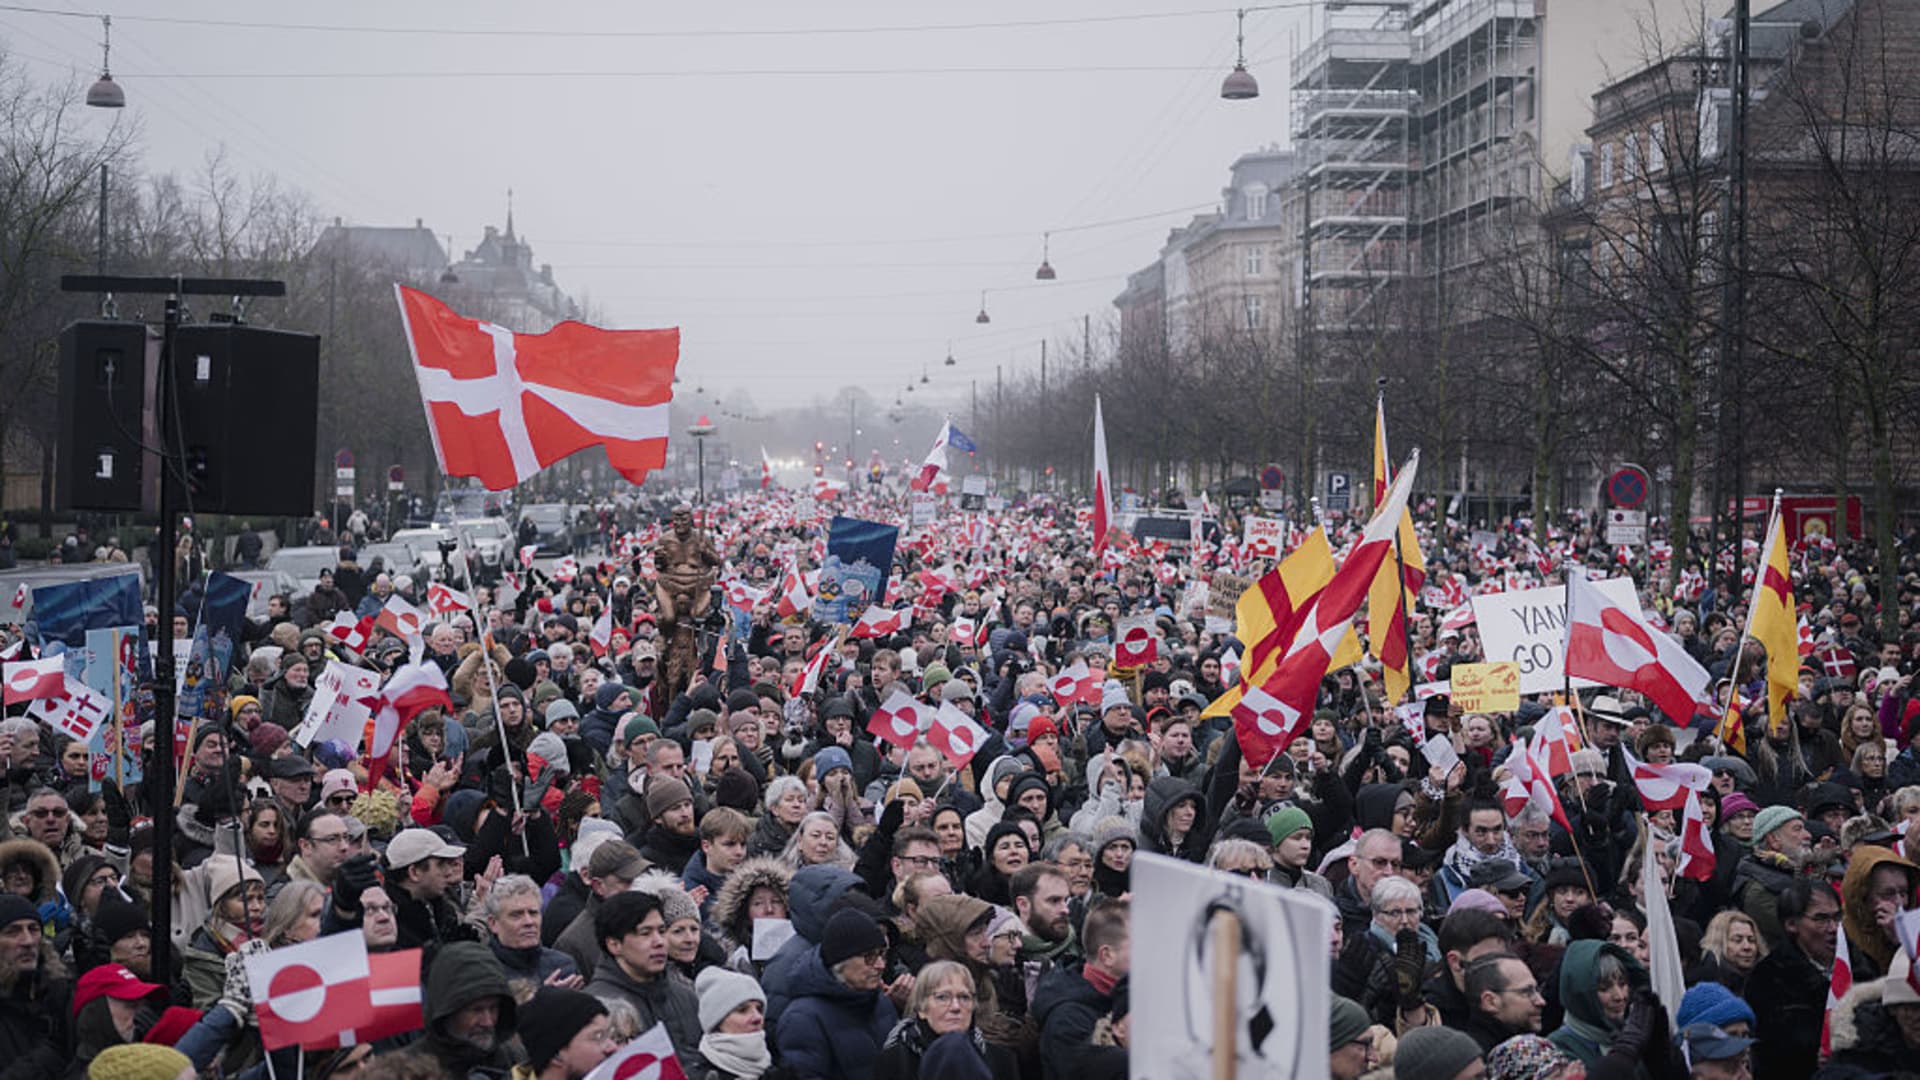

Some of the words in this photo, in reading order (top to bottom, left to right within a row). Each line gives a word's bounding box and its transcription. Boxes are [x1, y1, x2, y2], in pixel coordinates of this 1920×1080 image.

[1332, 474, 1346, 494] P
[1511, 605, 1567, 634] YAN
[1512, 642, 1553, 675] GO
